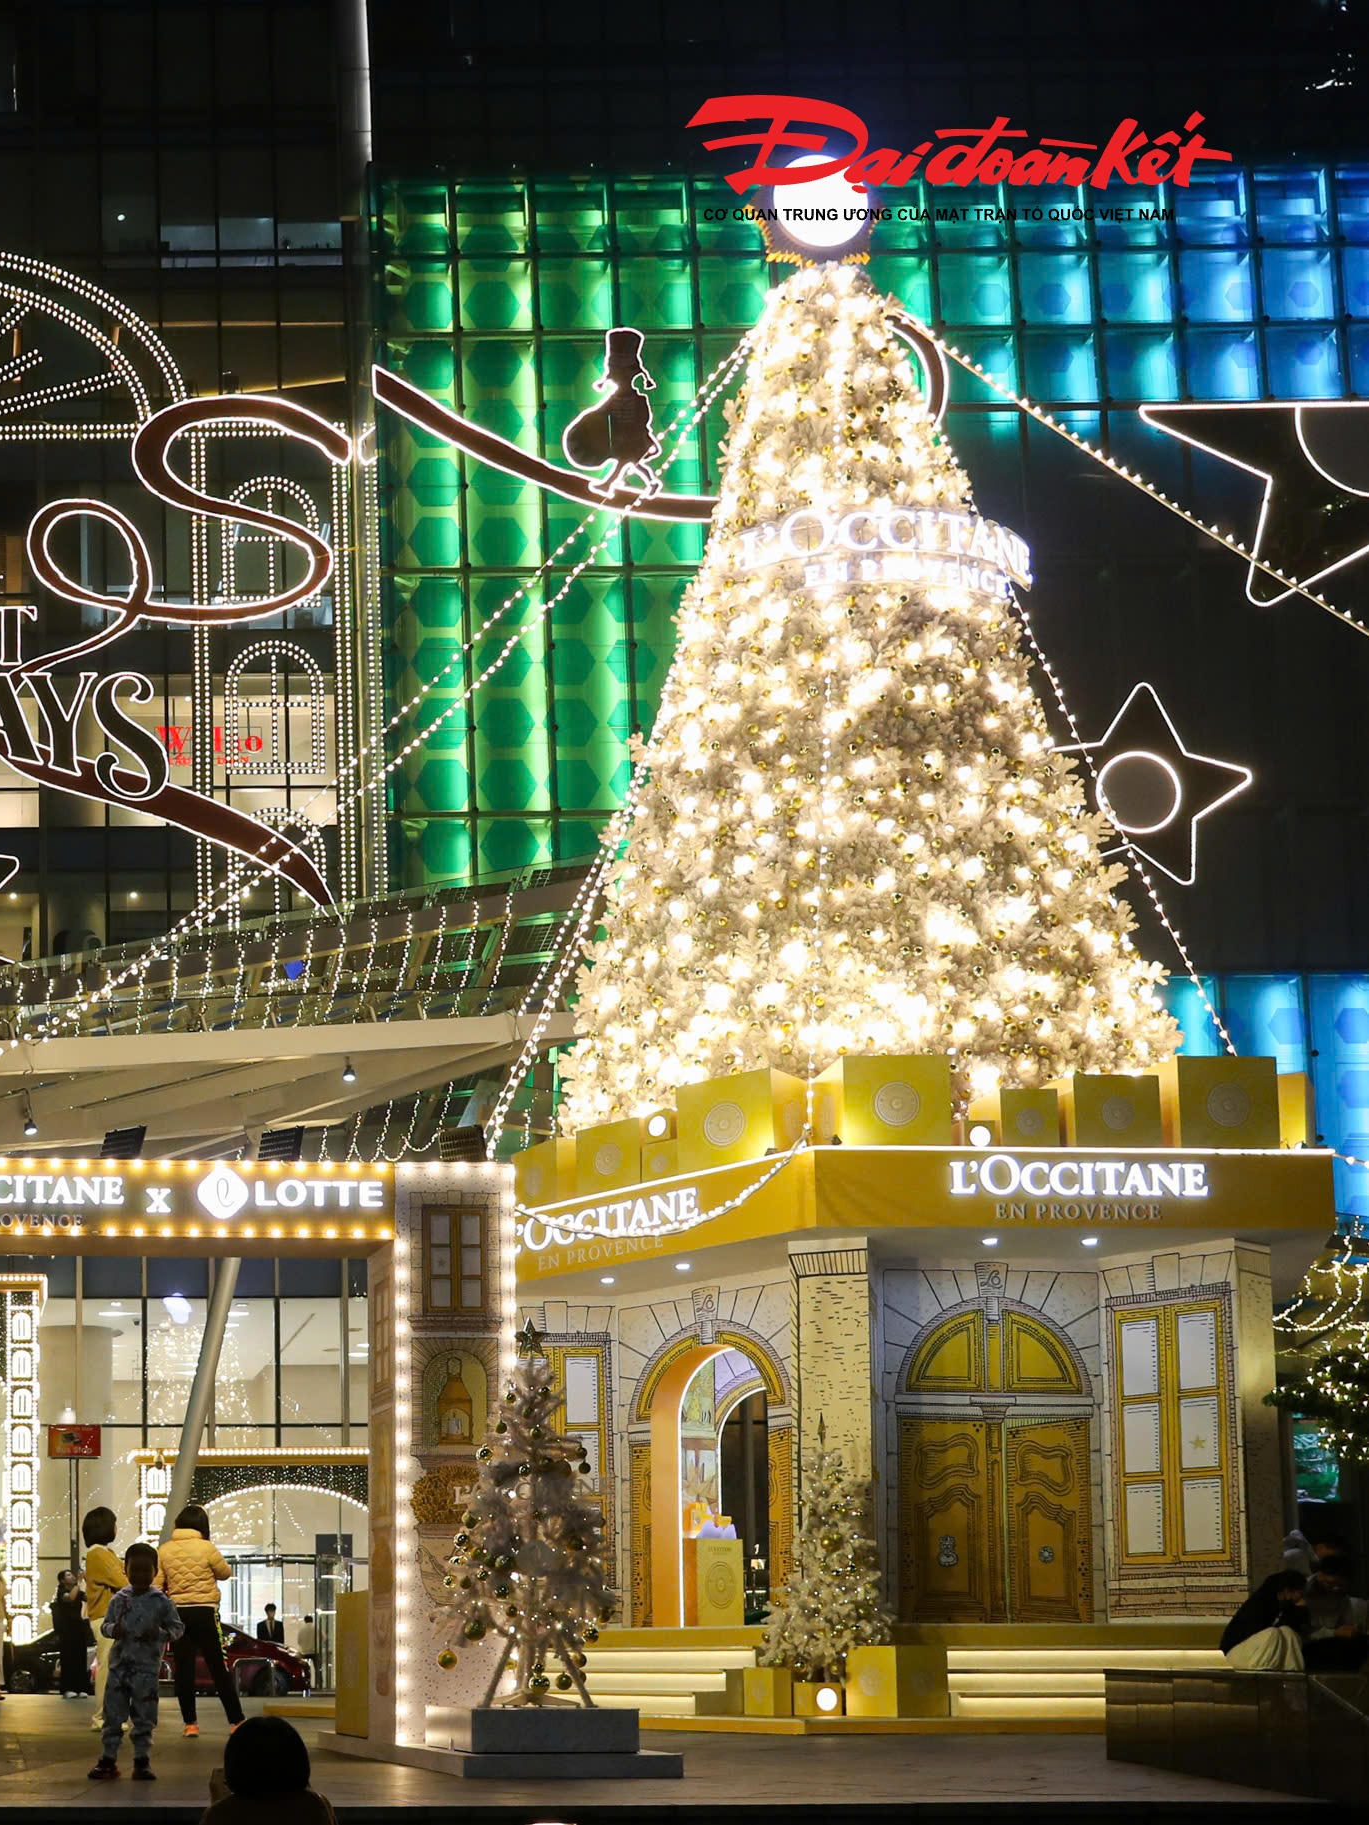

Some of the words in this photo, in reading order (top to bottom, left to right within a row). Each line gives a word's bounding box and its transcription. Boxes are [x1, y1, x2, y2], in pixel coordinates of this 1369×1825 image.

[254, 1180, 384, 1207] LOTTE
[949, 1154, 1209, 1197] L'OCCITANE
[515, 1186, 700, 1256] 'OCCITANE
[995, 1202, 1027, 1220] EN
[1035, 1202, 1162, 1220] PROVENCE
[538, 1253, 560, 1272] EN
[567, 1235, 664, 1265] PROVENCE
